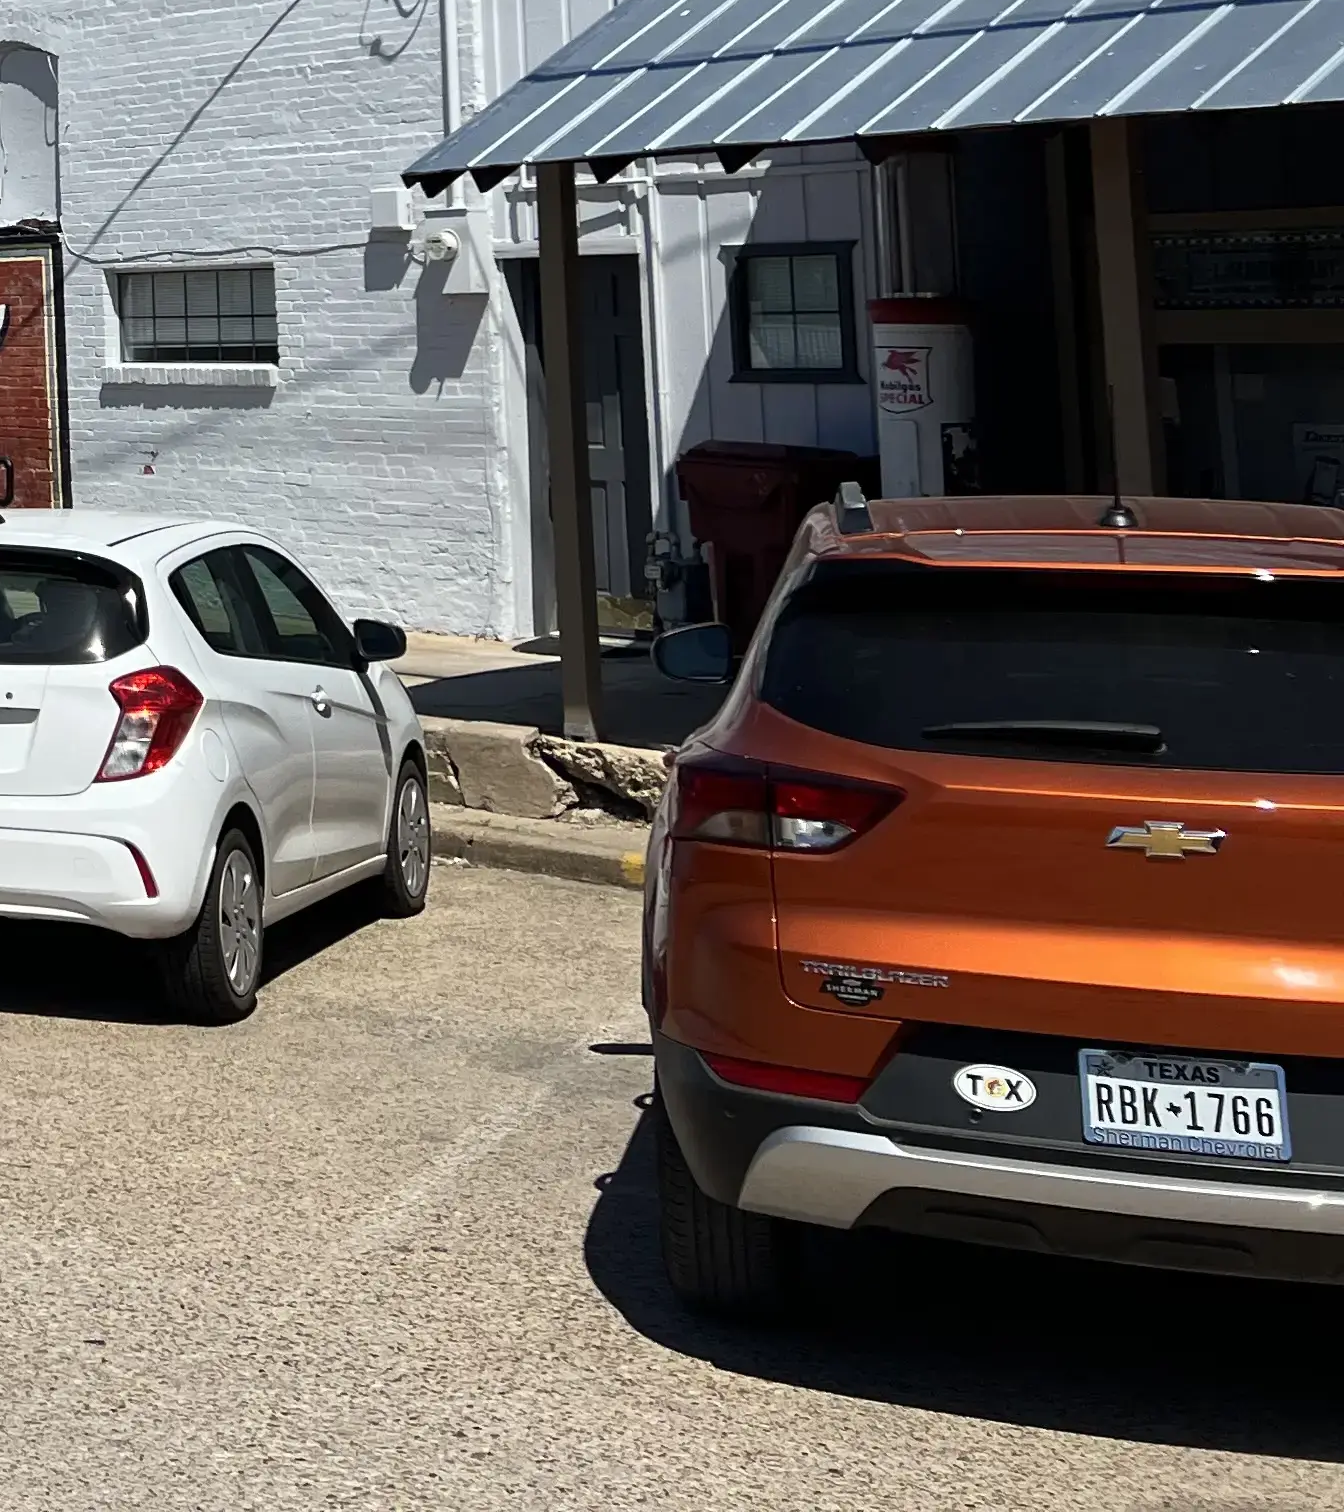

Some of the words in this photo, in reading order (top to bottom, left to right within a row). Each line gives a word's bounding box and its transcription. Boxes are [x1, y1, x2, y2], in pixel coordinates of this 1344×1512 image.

[880, 393, 925, 404] SPECIAL
[799, 960, 949, 988] TRAILBLAZER
[826, 983, 878, 997] SHERMAN
[1143, 1061, 1221, 1084] TEXAS
[1095, 1083, 1162, 1128] RBK
[1183, 1091, 1275, 1137] 1766
[1093, 1127, 1181, 1151] Sherman
[1188, 1136, 1284, 1160] Chevrolet
